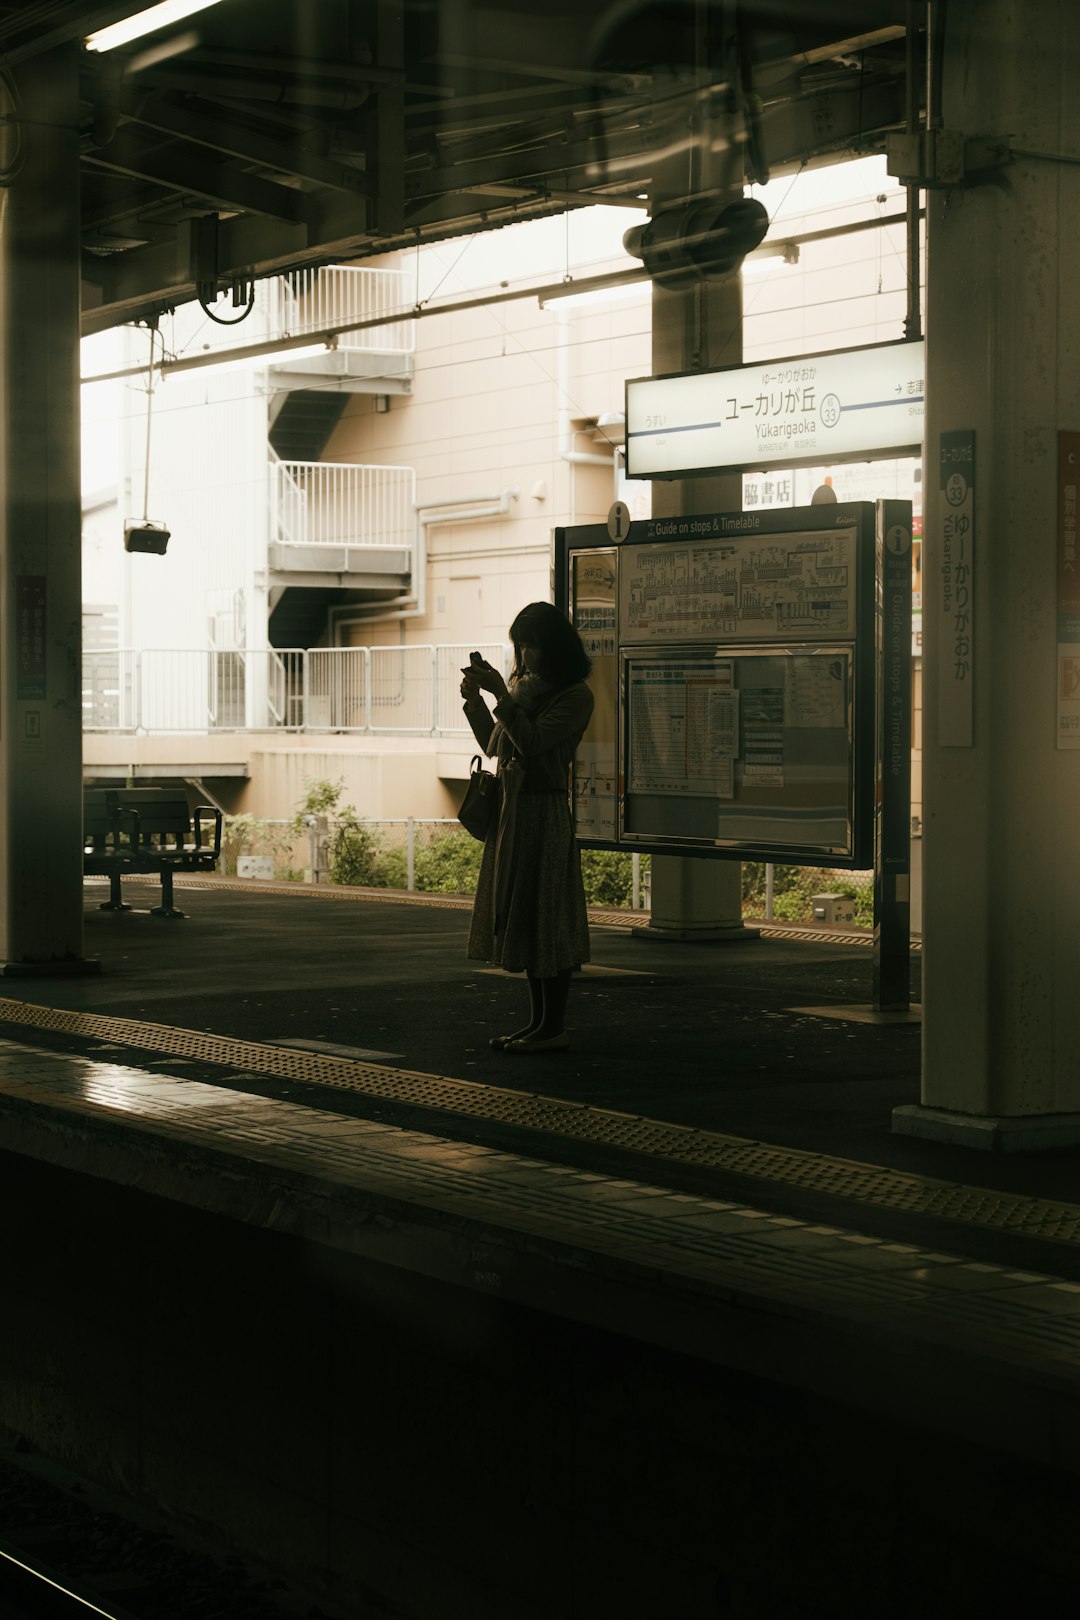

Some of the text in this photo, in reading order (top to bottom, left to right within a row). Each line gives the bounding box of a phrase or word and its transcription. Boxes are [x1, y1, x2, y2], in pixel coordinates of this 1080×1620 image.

[762, 367, 816, 384] ゆーかりがおか
[725, 386, 816, 420] ユーカリが丘
[645, 415, 667, 428] うすい
[824, 409, 836, 422] 33
[755, 419, 816, 439] Yūkarigaoka
[950, 486, 963, 501] 33
[655, 521, 678, 536] Guide
[678, 521, 689, 534] on
[690, 519, 711, 534] stops
[712, 518, 720, 532] &
[721, 514, 760, 530] Timetable
[954, 513, 970, 681] ゆーかりがおか
[892, 594, 904, 633] Guide
